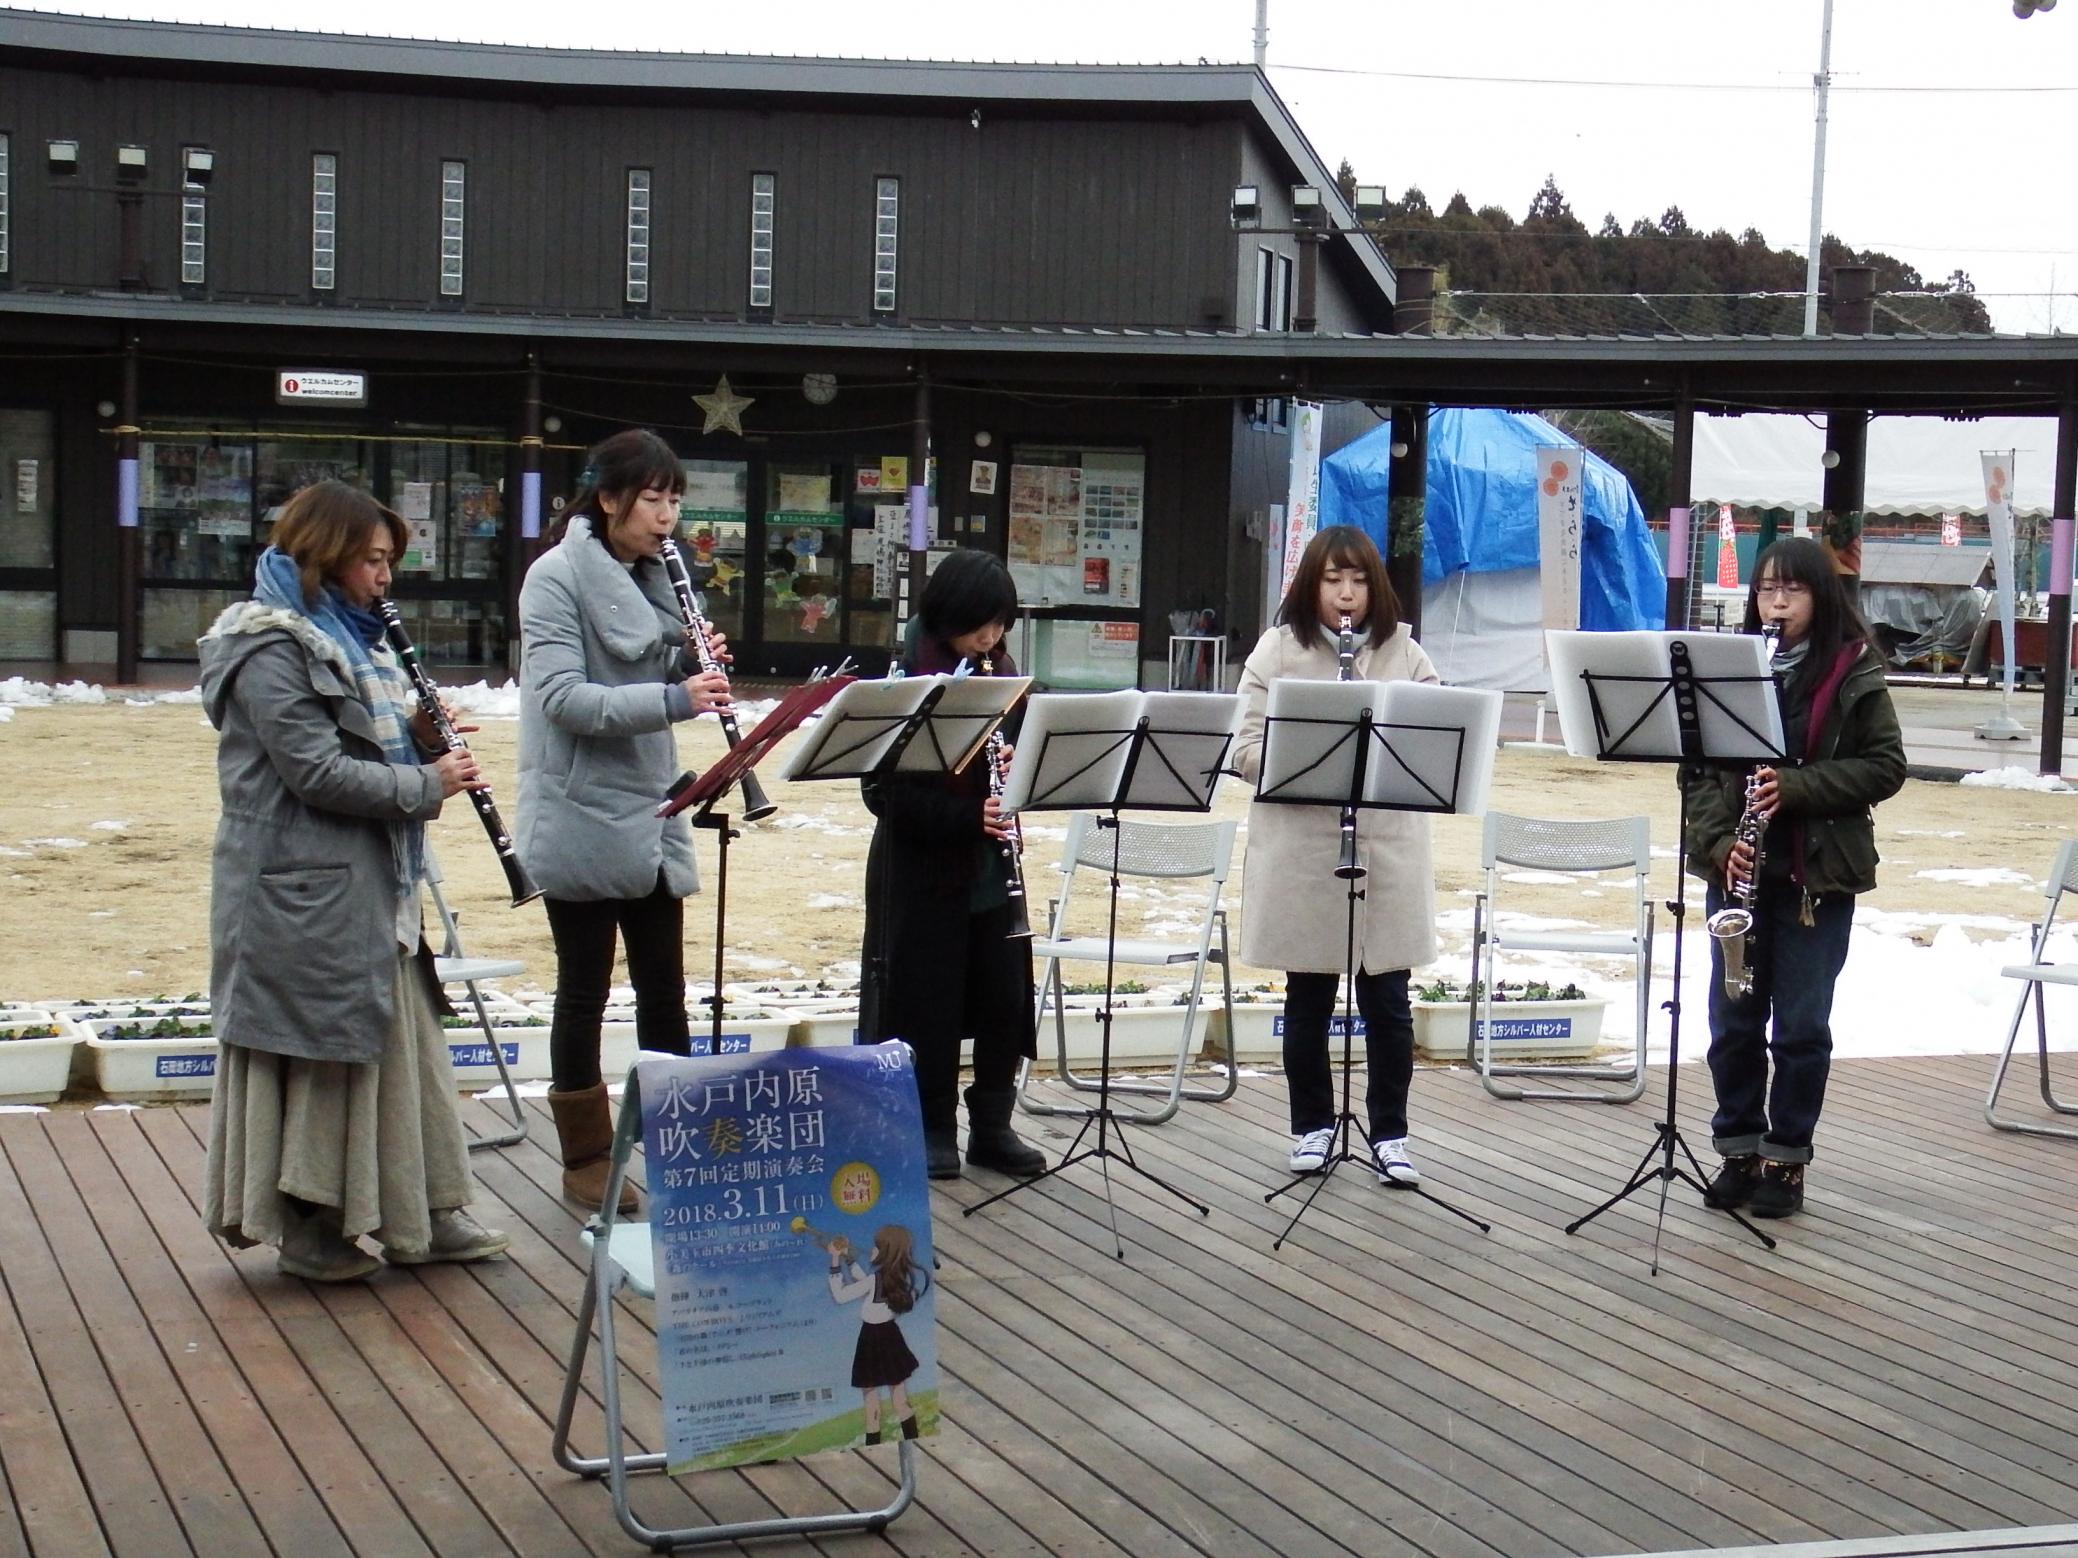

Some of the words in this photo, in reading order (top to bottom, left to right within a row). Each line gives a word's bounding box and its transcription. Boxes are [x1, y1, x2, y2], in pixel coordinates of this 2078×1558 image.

[301, 378, 359, 386] ウエルカムセンター
[1478, 1023, 1568, 1037] 石地方シルバー人材センター
[656, 1065, 824, 1119] 水戸内原
[658, 1109, 825, 1164] 吹奏楽団
[663, 1154, 824, 1189] 第7回定期演奏会
